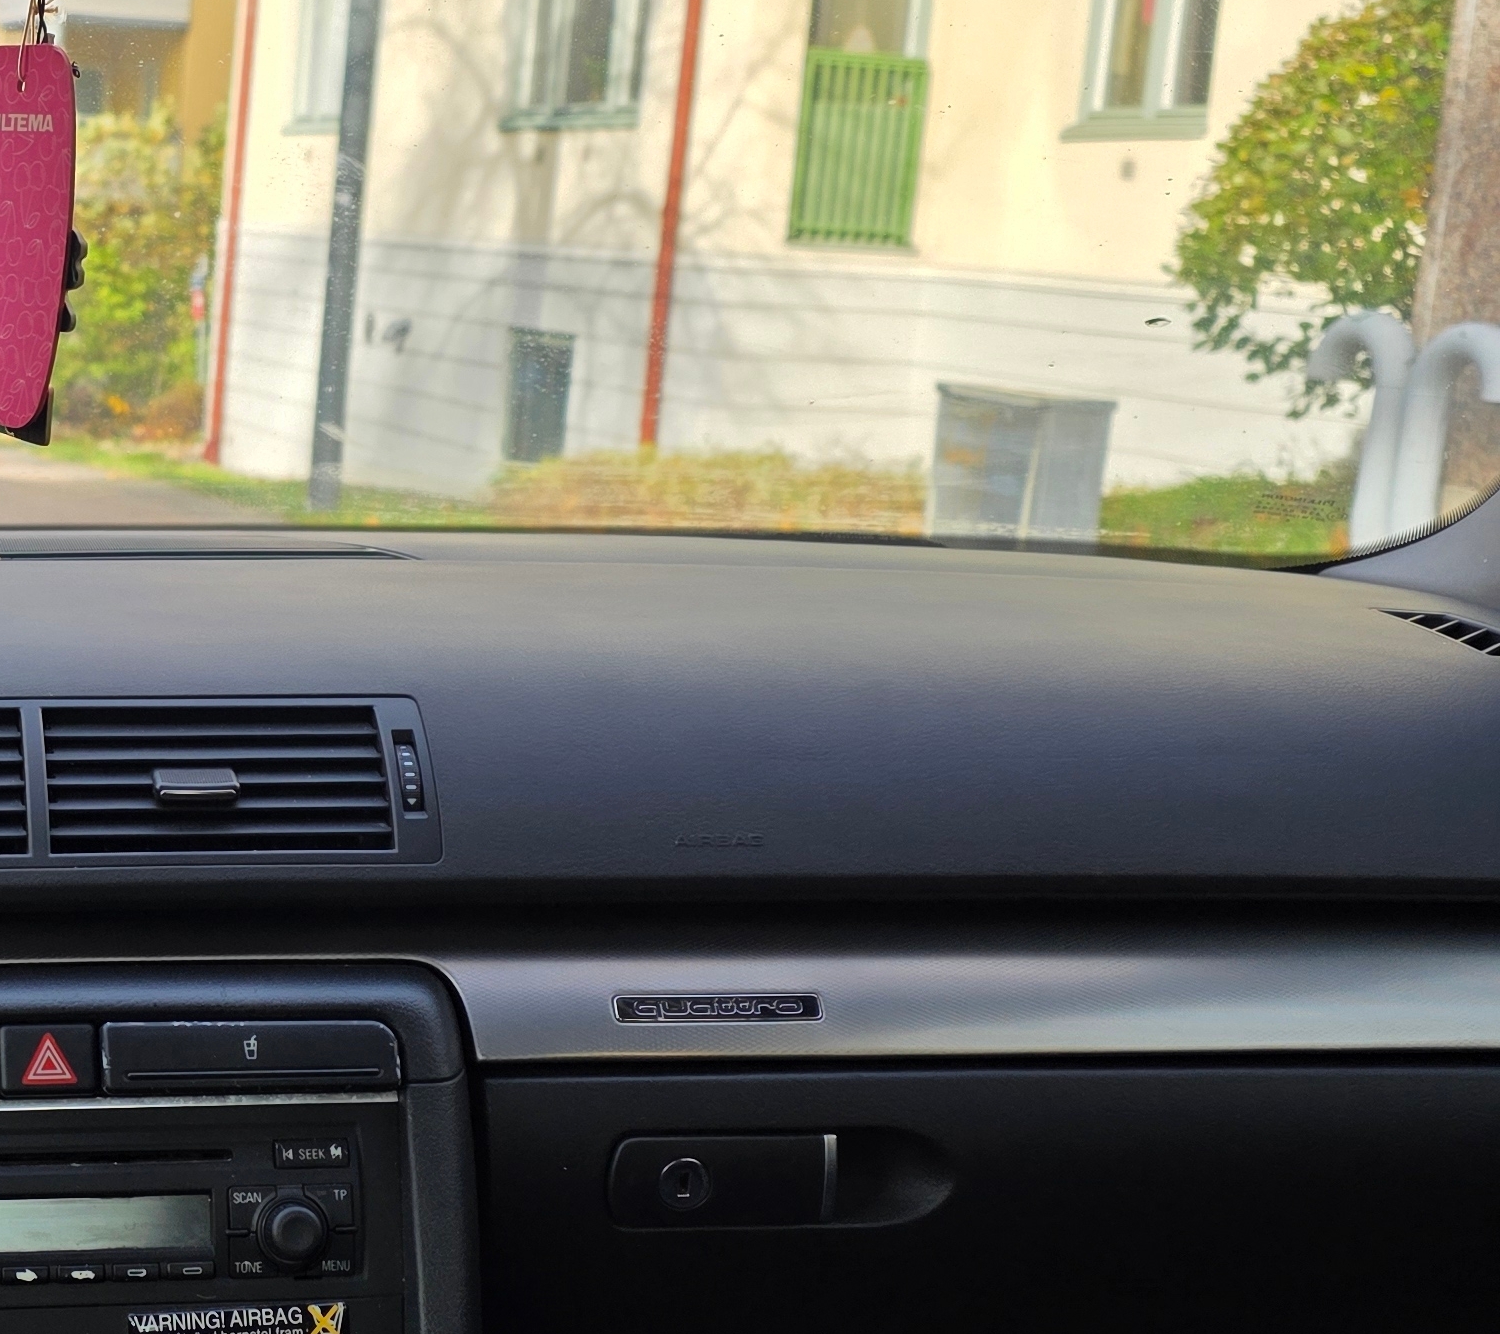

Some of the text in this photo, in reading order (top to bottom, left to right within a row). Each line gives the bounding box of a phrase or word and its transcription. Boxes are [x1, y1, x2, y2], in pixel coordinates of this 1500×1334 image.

[633, 998, 804, 1019] quattro
[298, 1148, 326, 1160] SEEK
[232, 1192, 262, 1204] SCAN
[333, 1189, 348, 1201] TP
[234, 1261, 263, 1274] TONE
[321, 1259, 351, 1272] MENU
[133, 1306, 303, 1333] VARNING! AIRBAG
